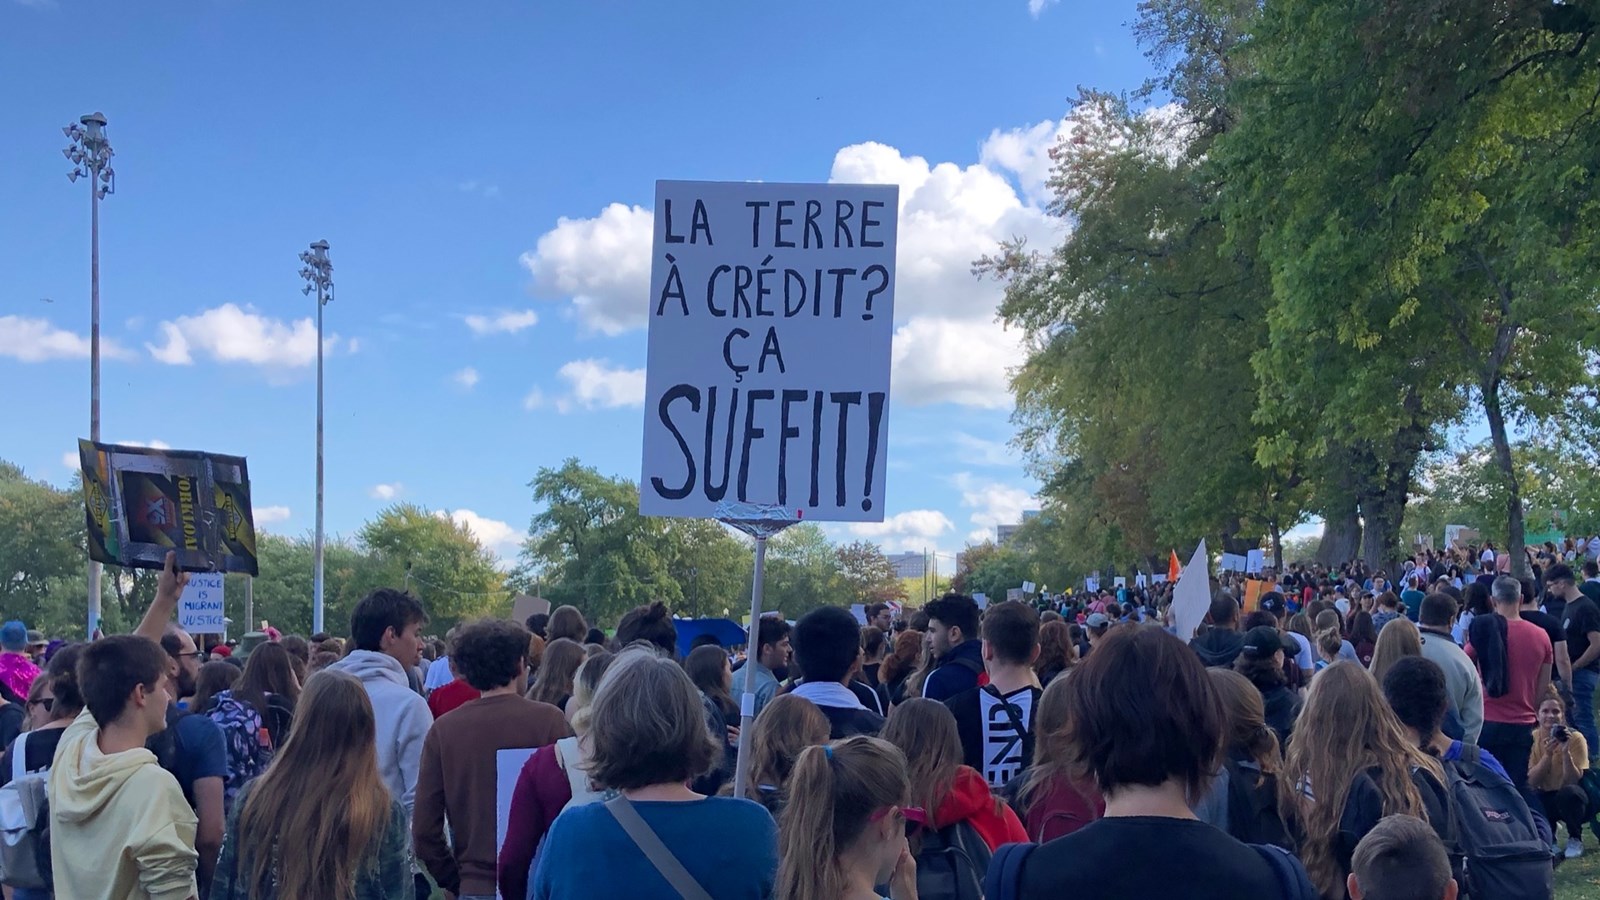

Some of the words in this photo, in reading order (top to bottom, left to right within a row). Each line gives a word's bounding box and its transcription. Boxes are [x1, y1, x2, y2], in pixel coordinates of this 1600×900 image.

[664, 198, 713, 246] LA
[745, 199, 885, 249] TERRE
[656, 253, 690, 316] À
[706, 254, 890, 321] CRÉDIT?
[722, 326, 786, 382] ÇA
[651, 383, 886, 512] SUFFIT!
[182, 614, 223, 626] JUSTICE
[198, 590, 208, 600] IS
